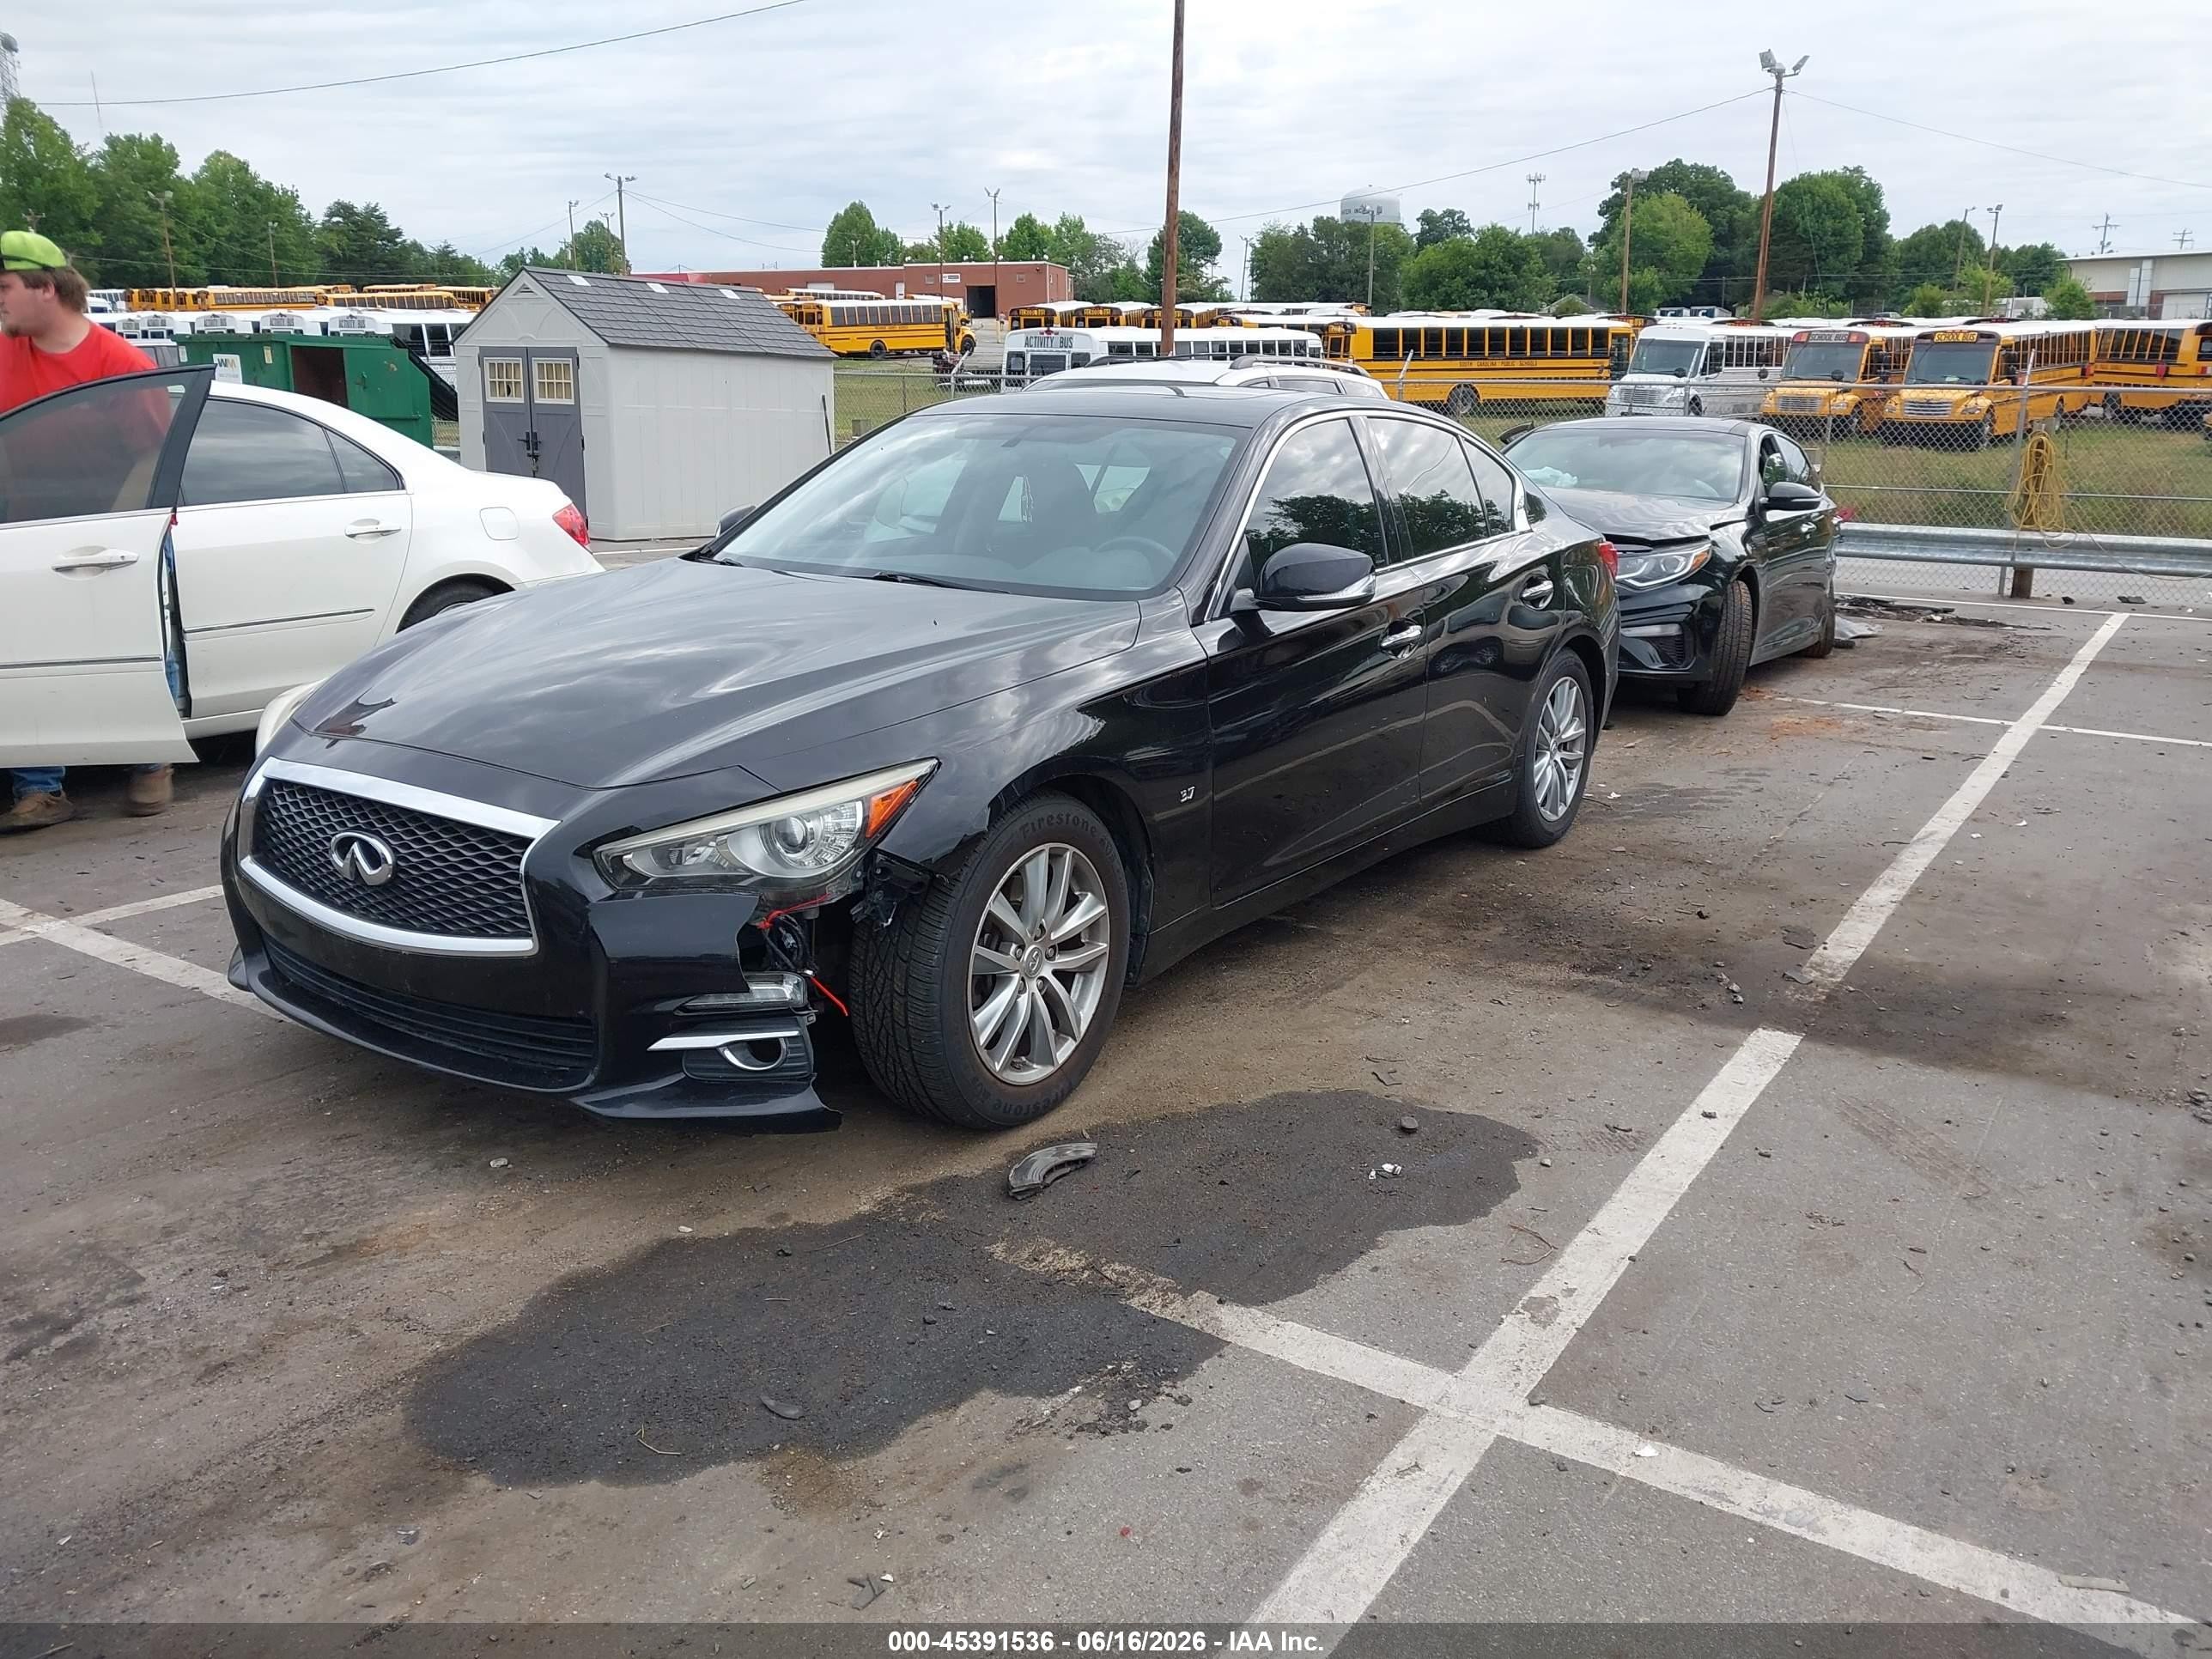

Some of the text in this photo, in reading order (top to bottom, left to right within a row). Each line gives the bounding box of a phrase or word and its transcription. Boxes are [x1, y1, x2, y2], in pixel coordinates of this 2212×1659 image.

[1024, 336, 1073, 349] ACTIVITY BUS
[1810, 333, 1850, 342] SCHOOL BUS
[217, 358, 237, 370] WM
[1018, 811, 1097, 839] Firestone
